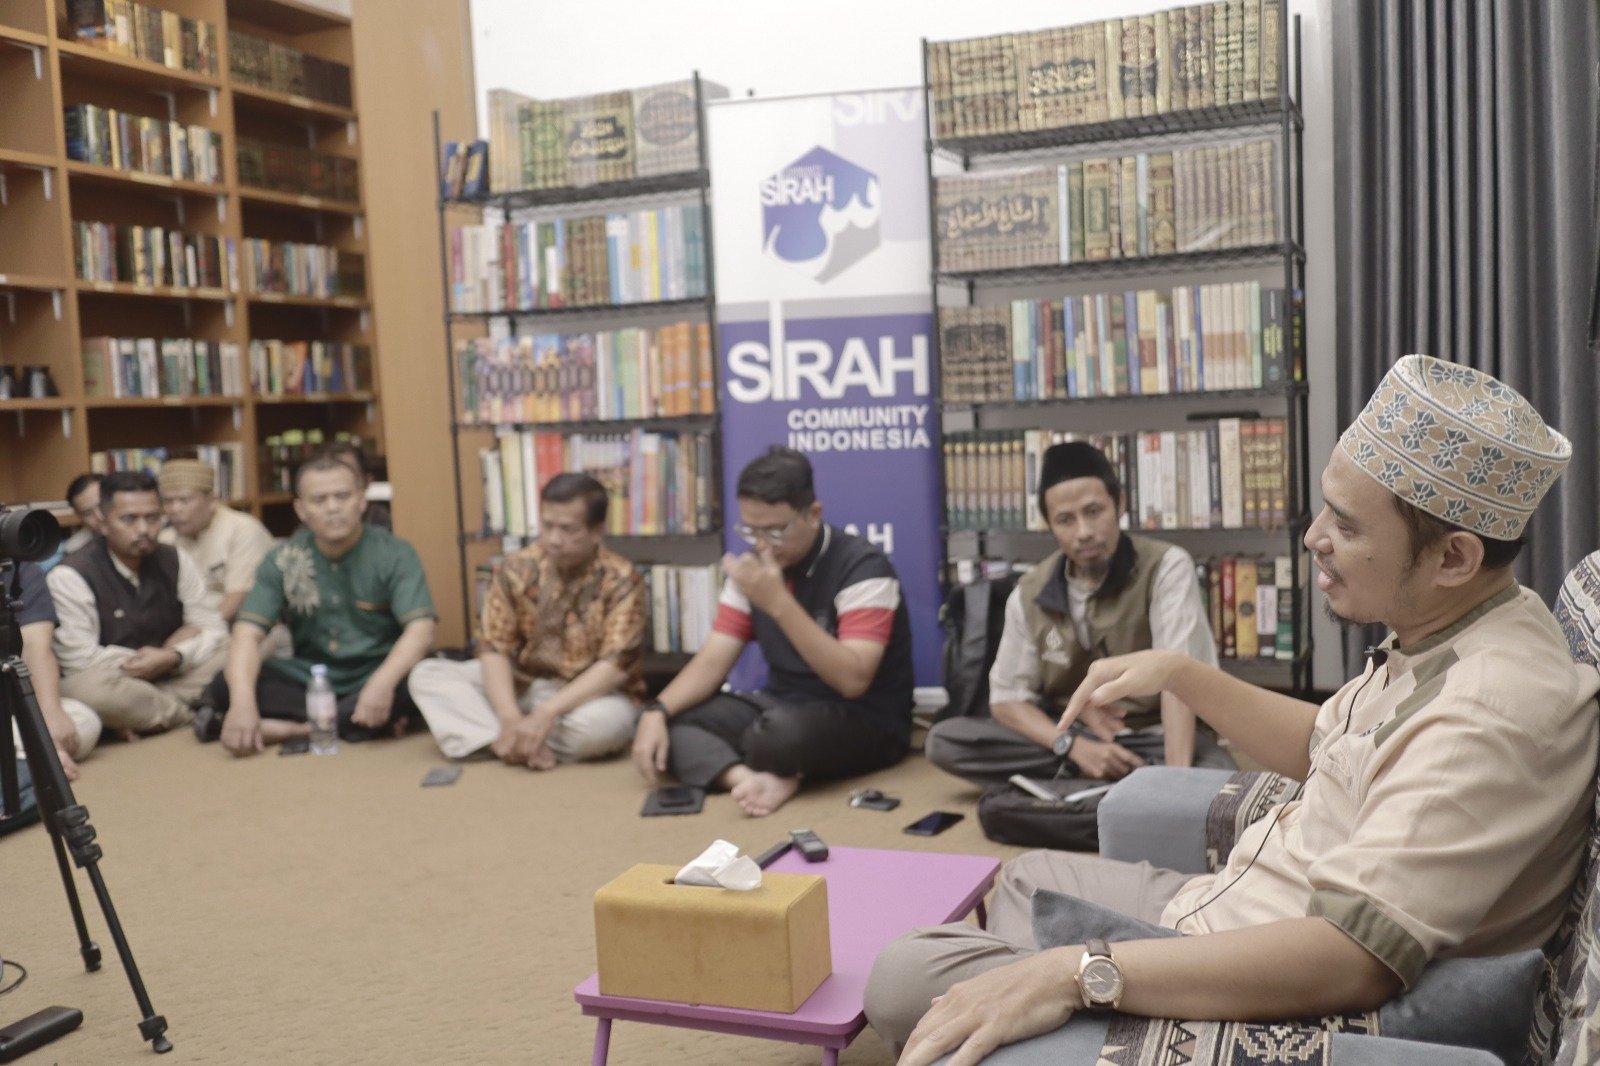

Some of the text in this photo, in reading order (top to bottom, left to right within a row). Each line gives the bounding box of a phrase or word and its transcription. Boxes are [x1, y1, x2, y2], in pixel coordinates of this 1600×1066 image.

[761, 171, 834, 206] SIRAH
[728, 301, 929, 402] SIRAH
[788, 406, 928, 428] COMMUNITY
[789, 429, 929, 452] INDONESIA
